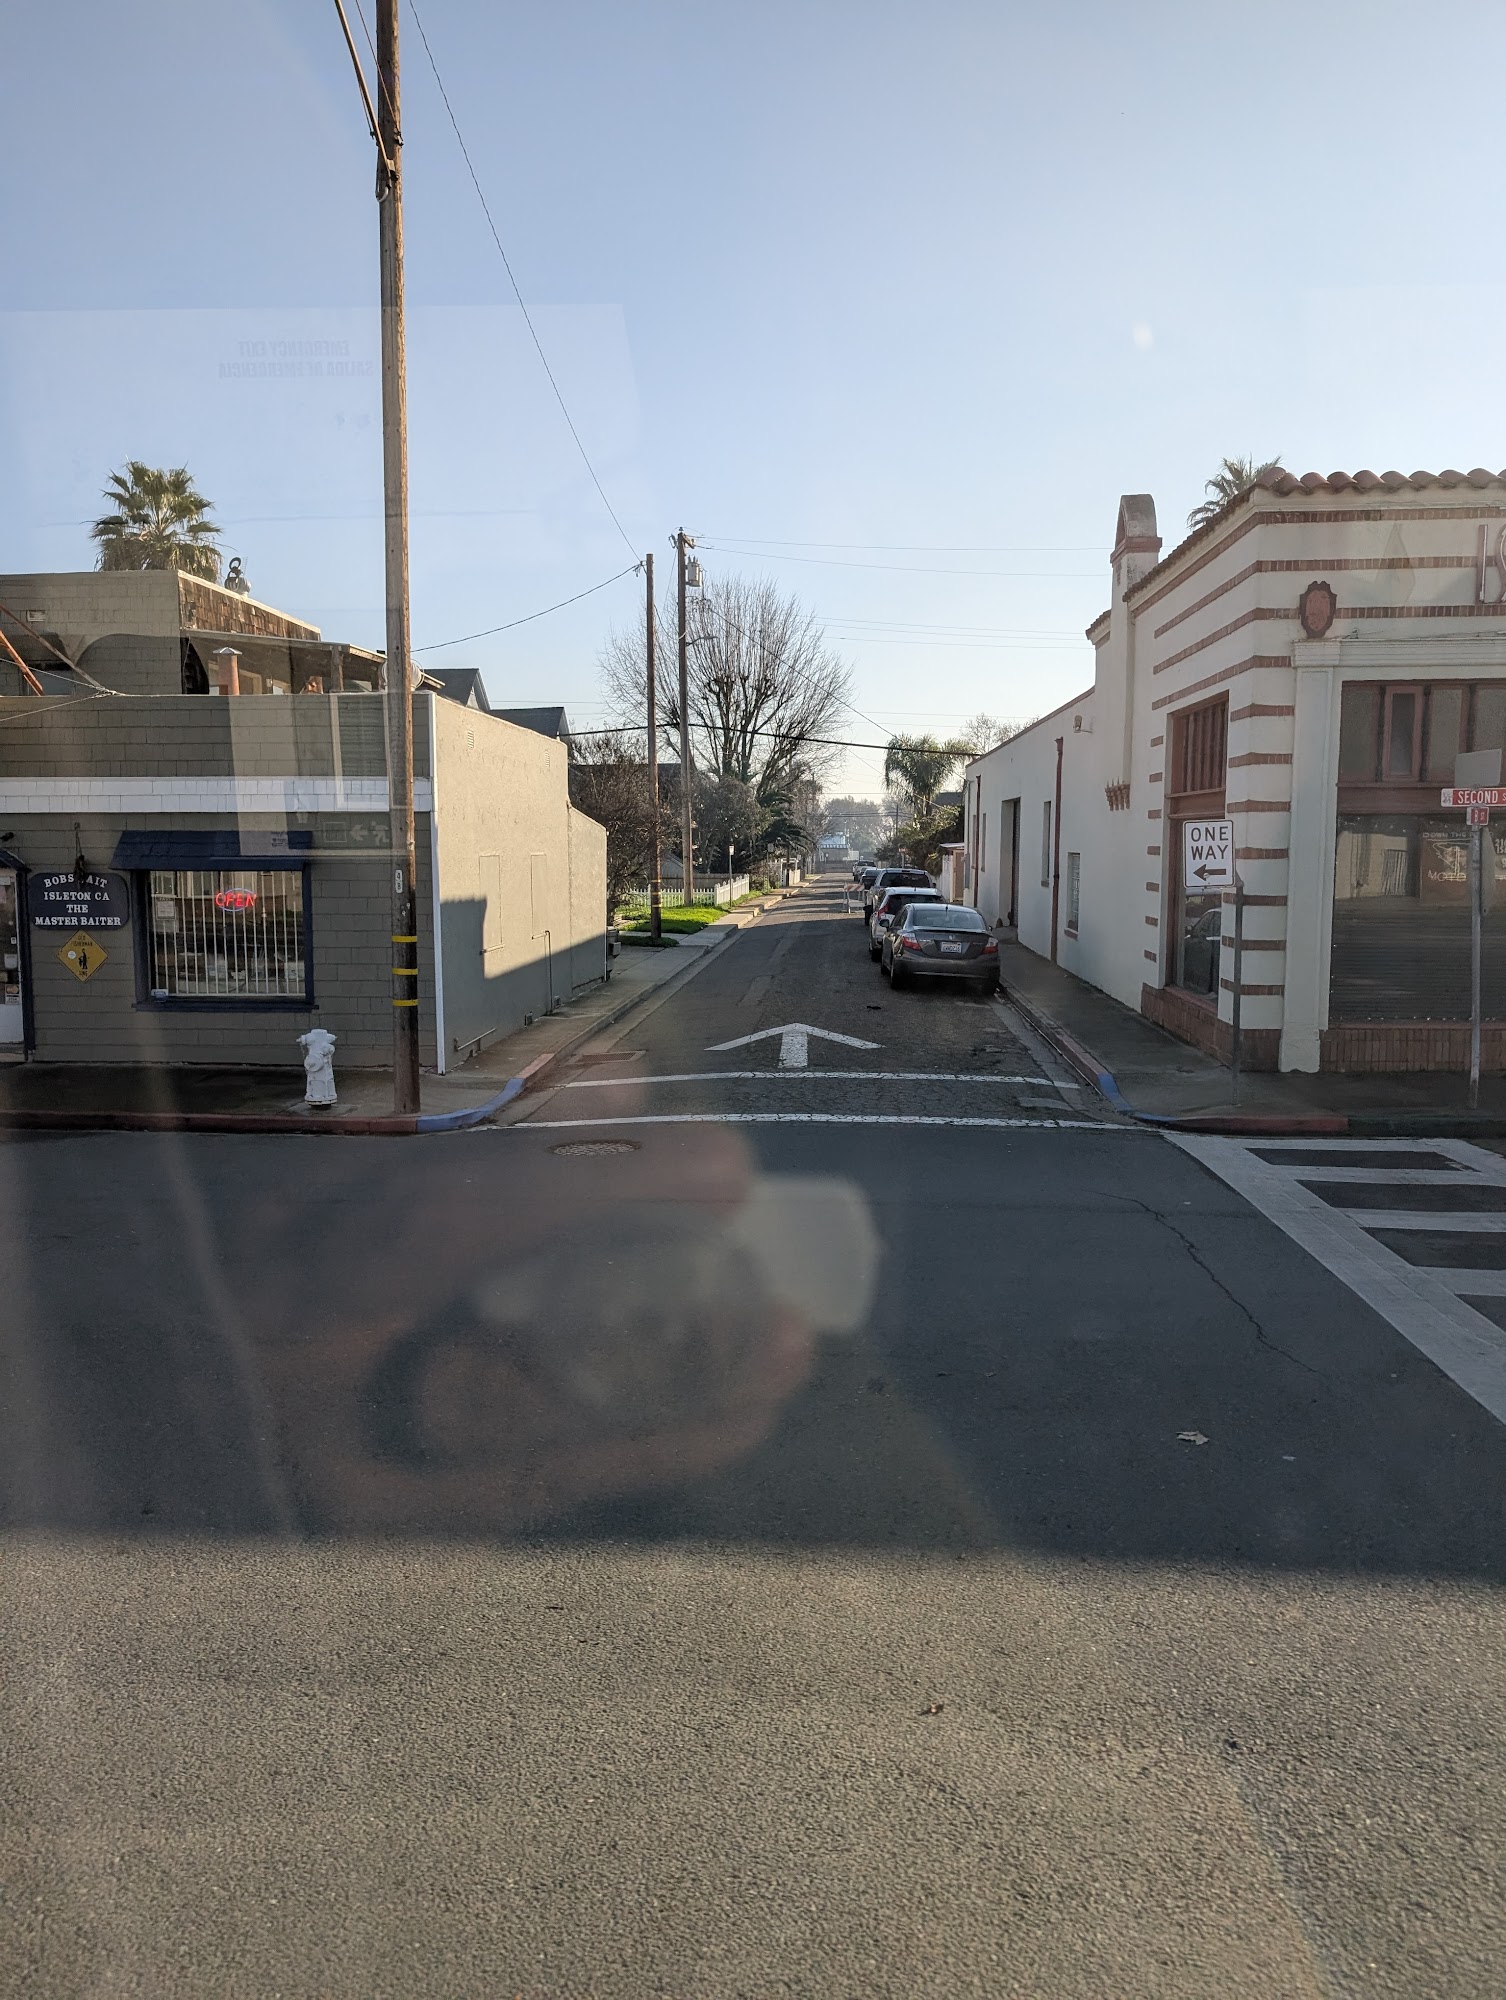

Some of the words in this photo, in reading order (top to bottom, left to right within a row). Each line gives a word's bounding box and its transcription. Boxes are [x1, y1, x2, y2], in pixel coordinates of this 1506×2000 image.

[1457, 790, 1499, 804] SECOND
[1191, 826, 1229, 842] ONE
[1191, 844, 1229, 861] WAY
[44, 874, 75, 888] BOBS
[82, 875, 108, 888] AIT
[44, 892, 91, 901] ISLETON
[95, 892, 110, 901] CA
[215, 892, 257, 907] OPEN
[66, 904, 89, 913] THE
[35, 917, 79, 926] MASTER
[80, 917, 121, 926] BAITER
